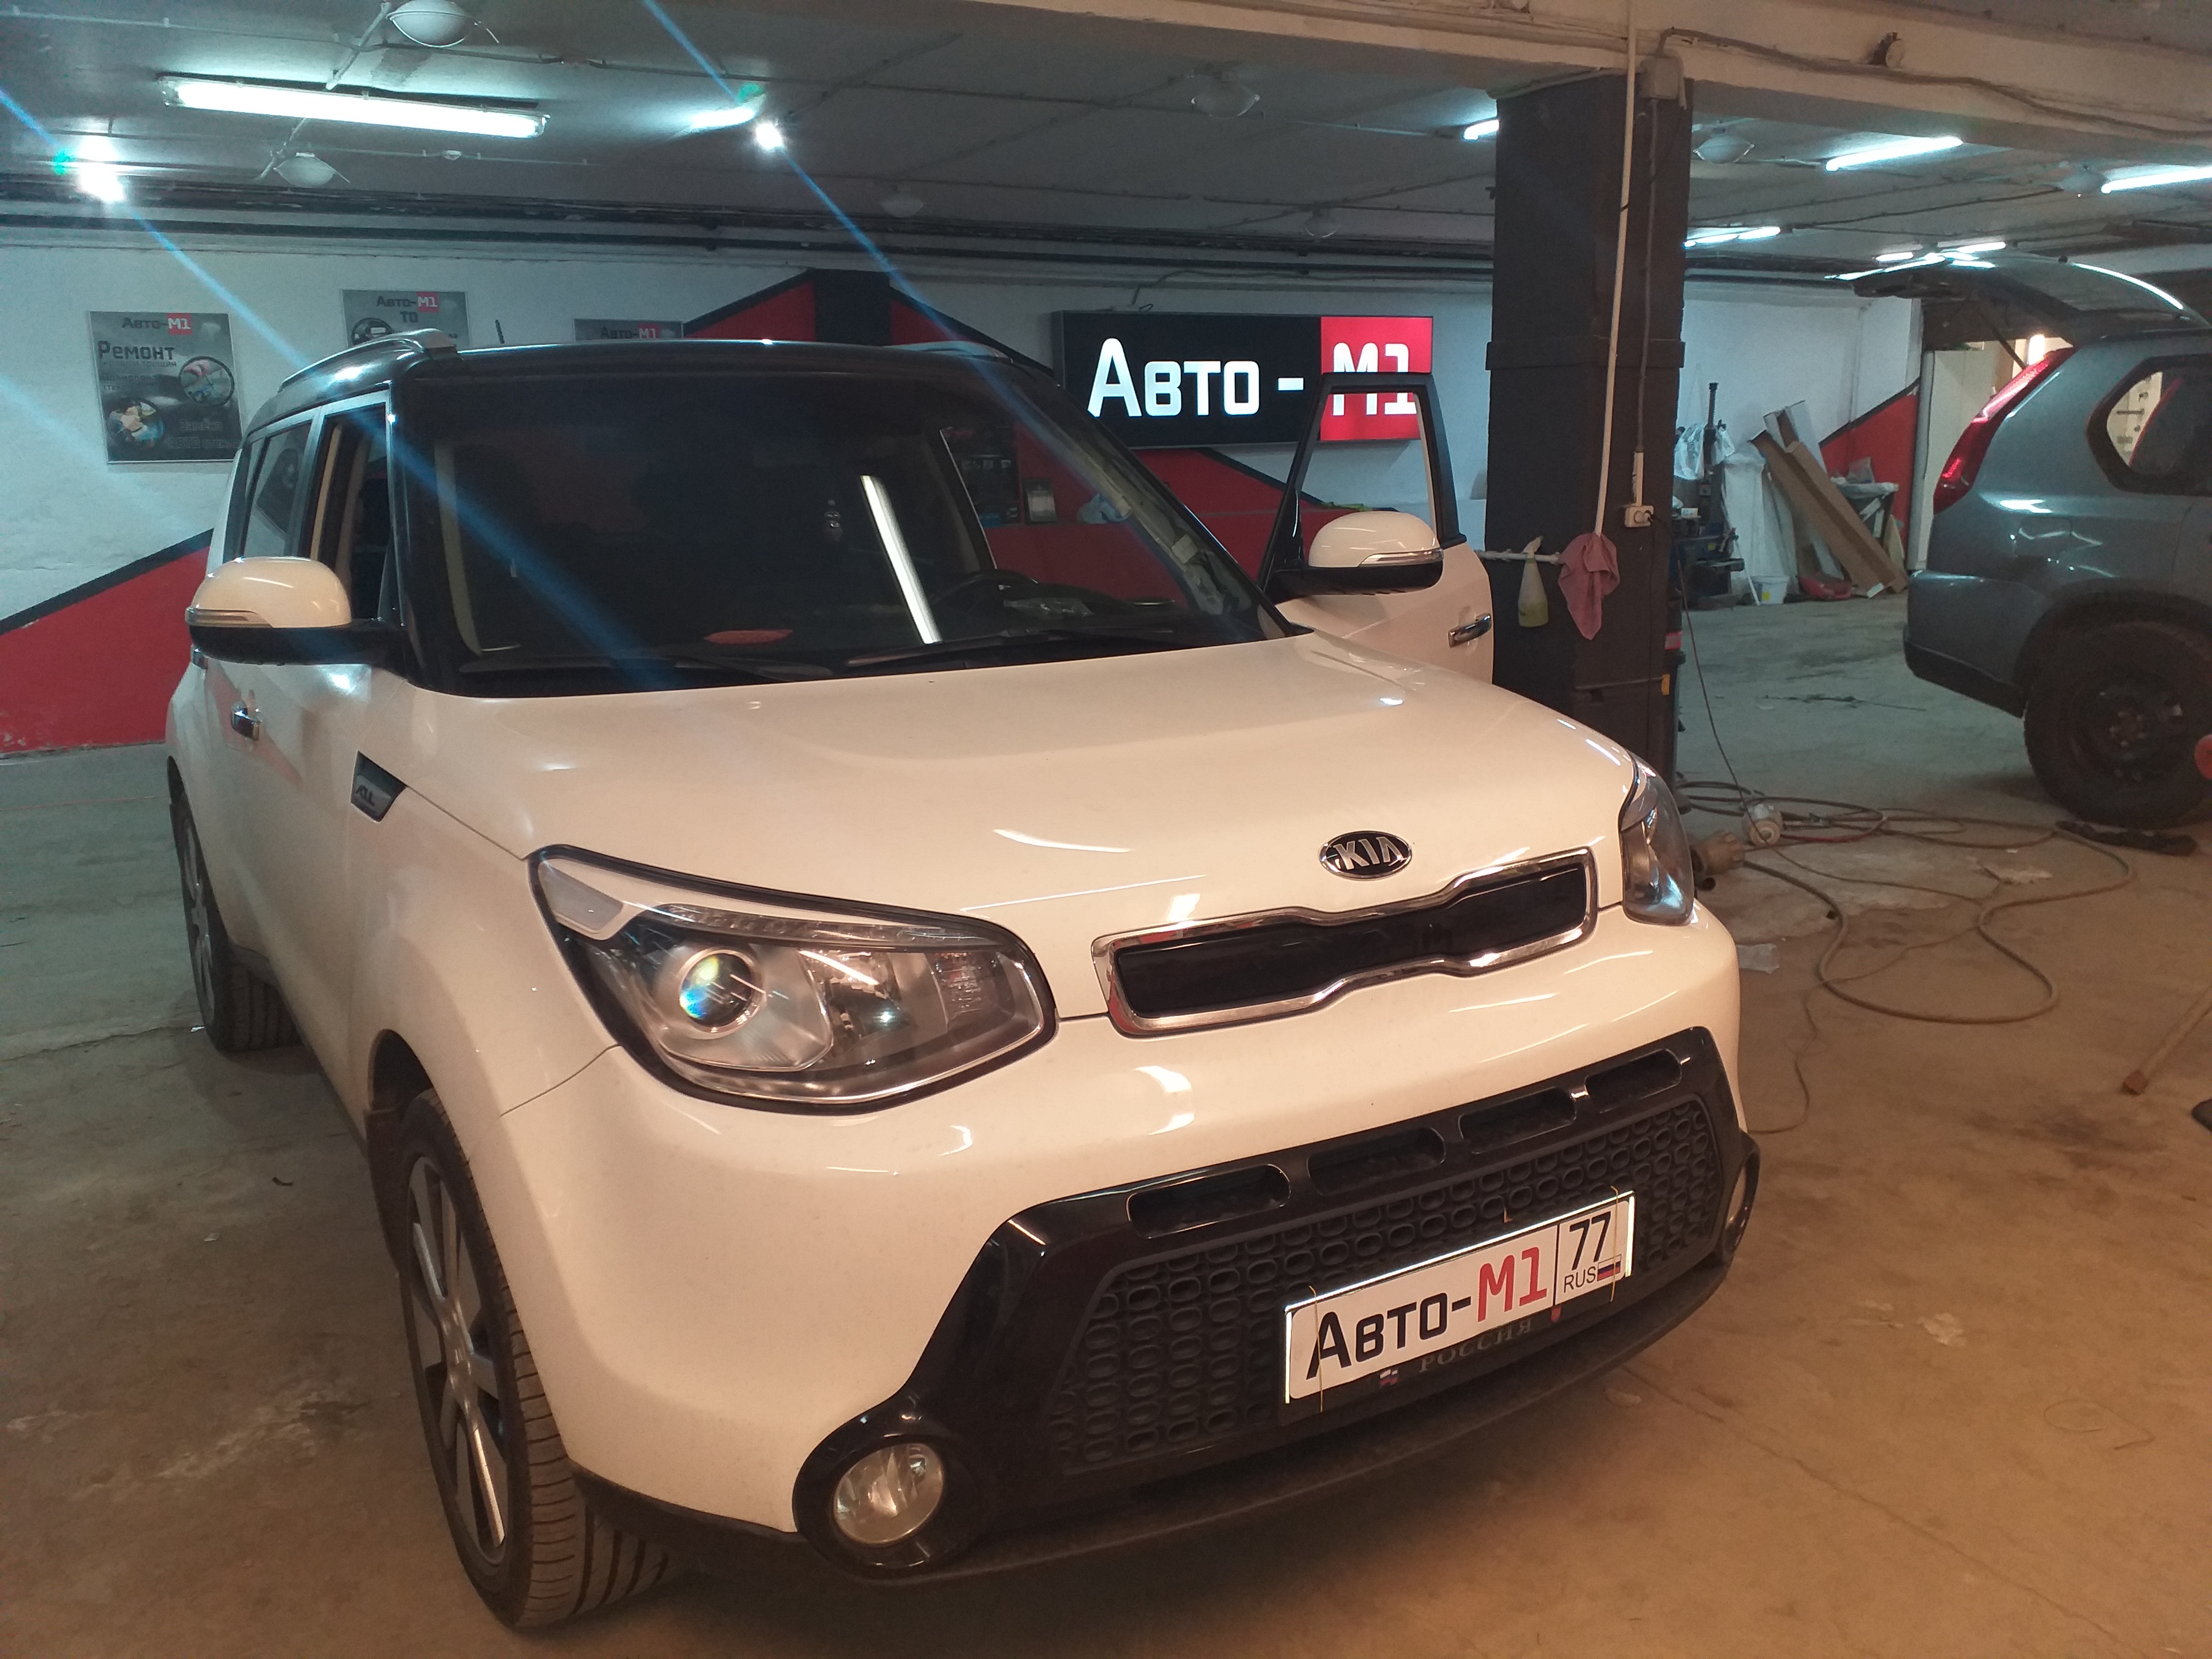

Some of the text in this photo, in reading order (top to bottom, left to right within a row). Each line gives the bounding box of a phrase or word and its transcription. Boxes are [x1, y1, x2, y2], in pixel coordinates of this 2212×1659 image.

[377, 295, 438, 307] Авто-М1
[122, 317, 191, 330] Авто-М1
[98, 340, 175, 360] Ремонт
[1087, 338, 1259, 417] Авто
[1333, 836, 1406, 870] KIA
[1570, 1210, 1611, 1271] 77
[1564, 1266, 1596, 1293] RUS
[1306, 1246, 1548, 1380] Авто-М1
[1418, 1318, 1533, 1373] РОССИЯ
